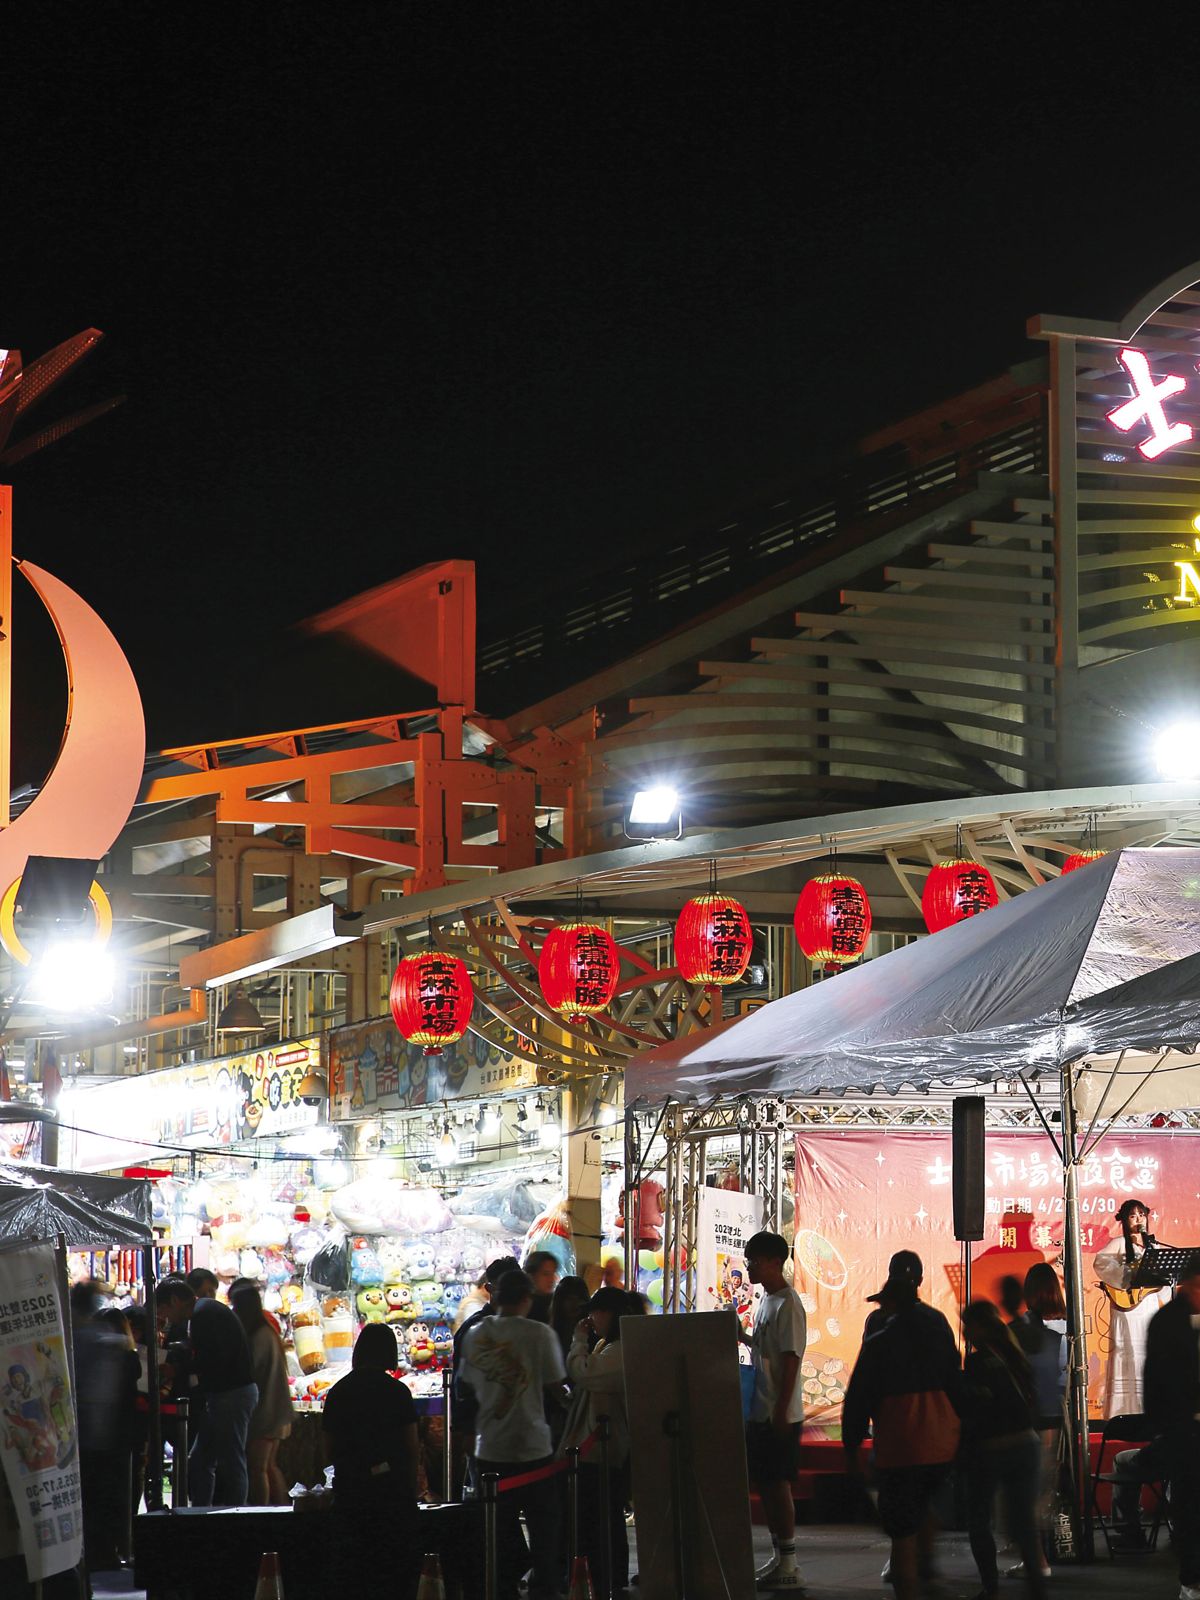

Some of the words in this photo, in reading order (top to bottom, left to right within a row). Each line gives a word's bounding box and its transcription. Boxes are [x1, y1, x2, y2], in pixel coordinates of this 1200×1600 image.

[957, 869, 991, 921] 士林市
[710, 908, 746, 976] 士林市場
[417, 961, 458, 1032] 士林市場
[926, 1147, 1160, 1193] 士市場夜食堂
[986, 1197, 1032, 1214] 動日期
[1037, 1197, 1116, 1215] 4/26/30
